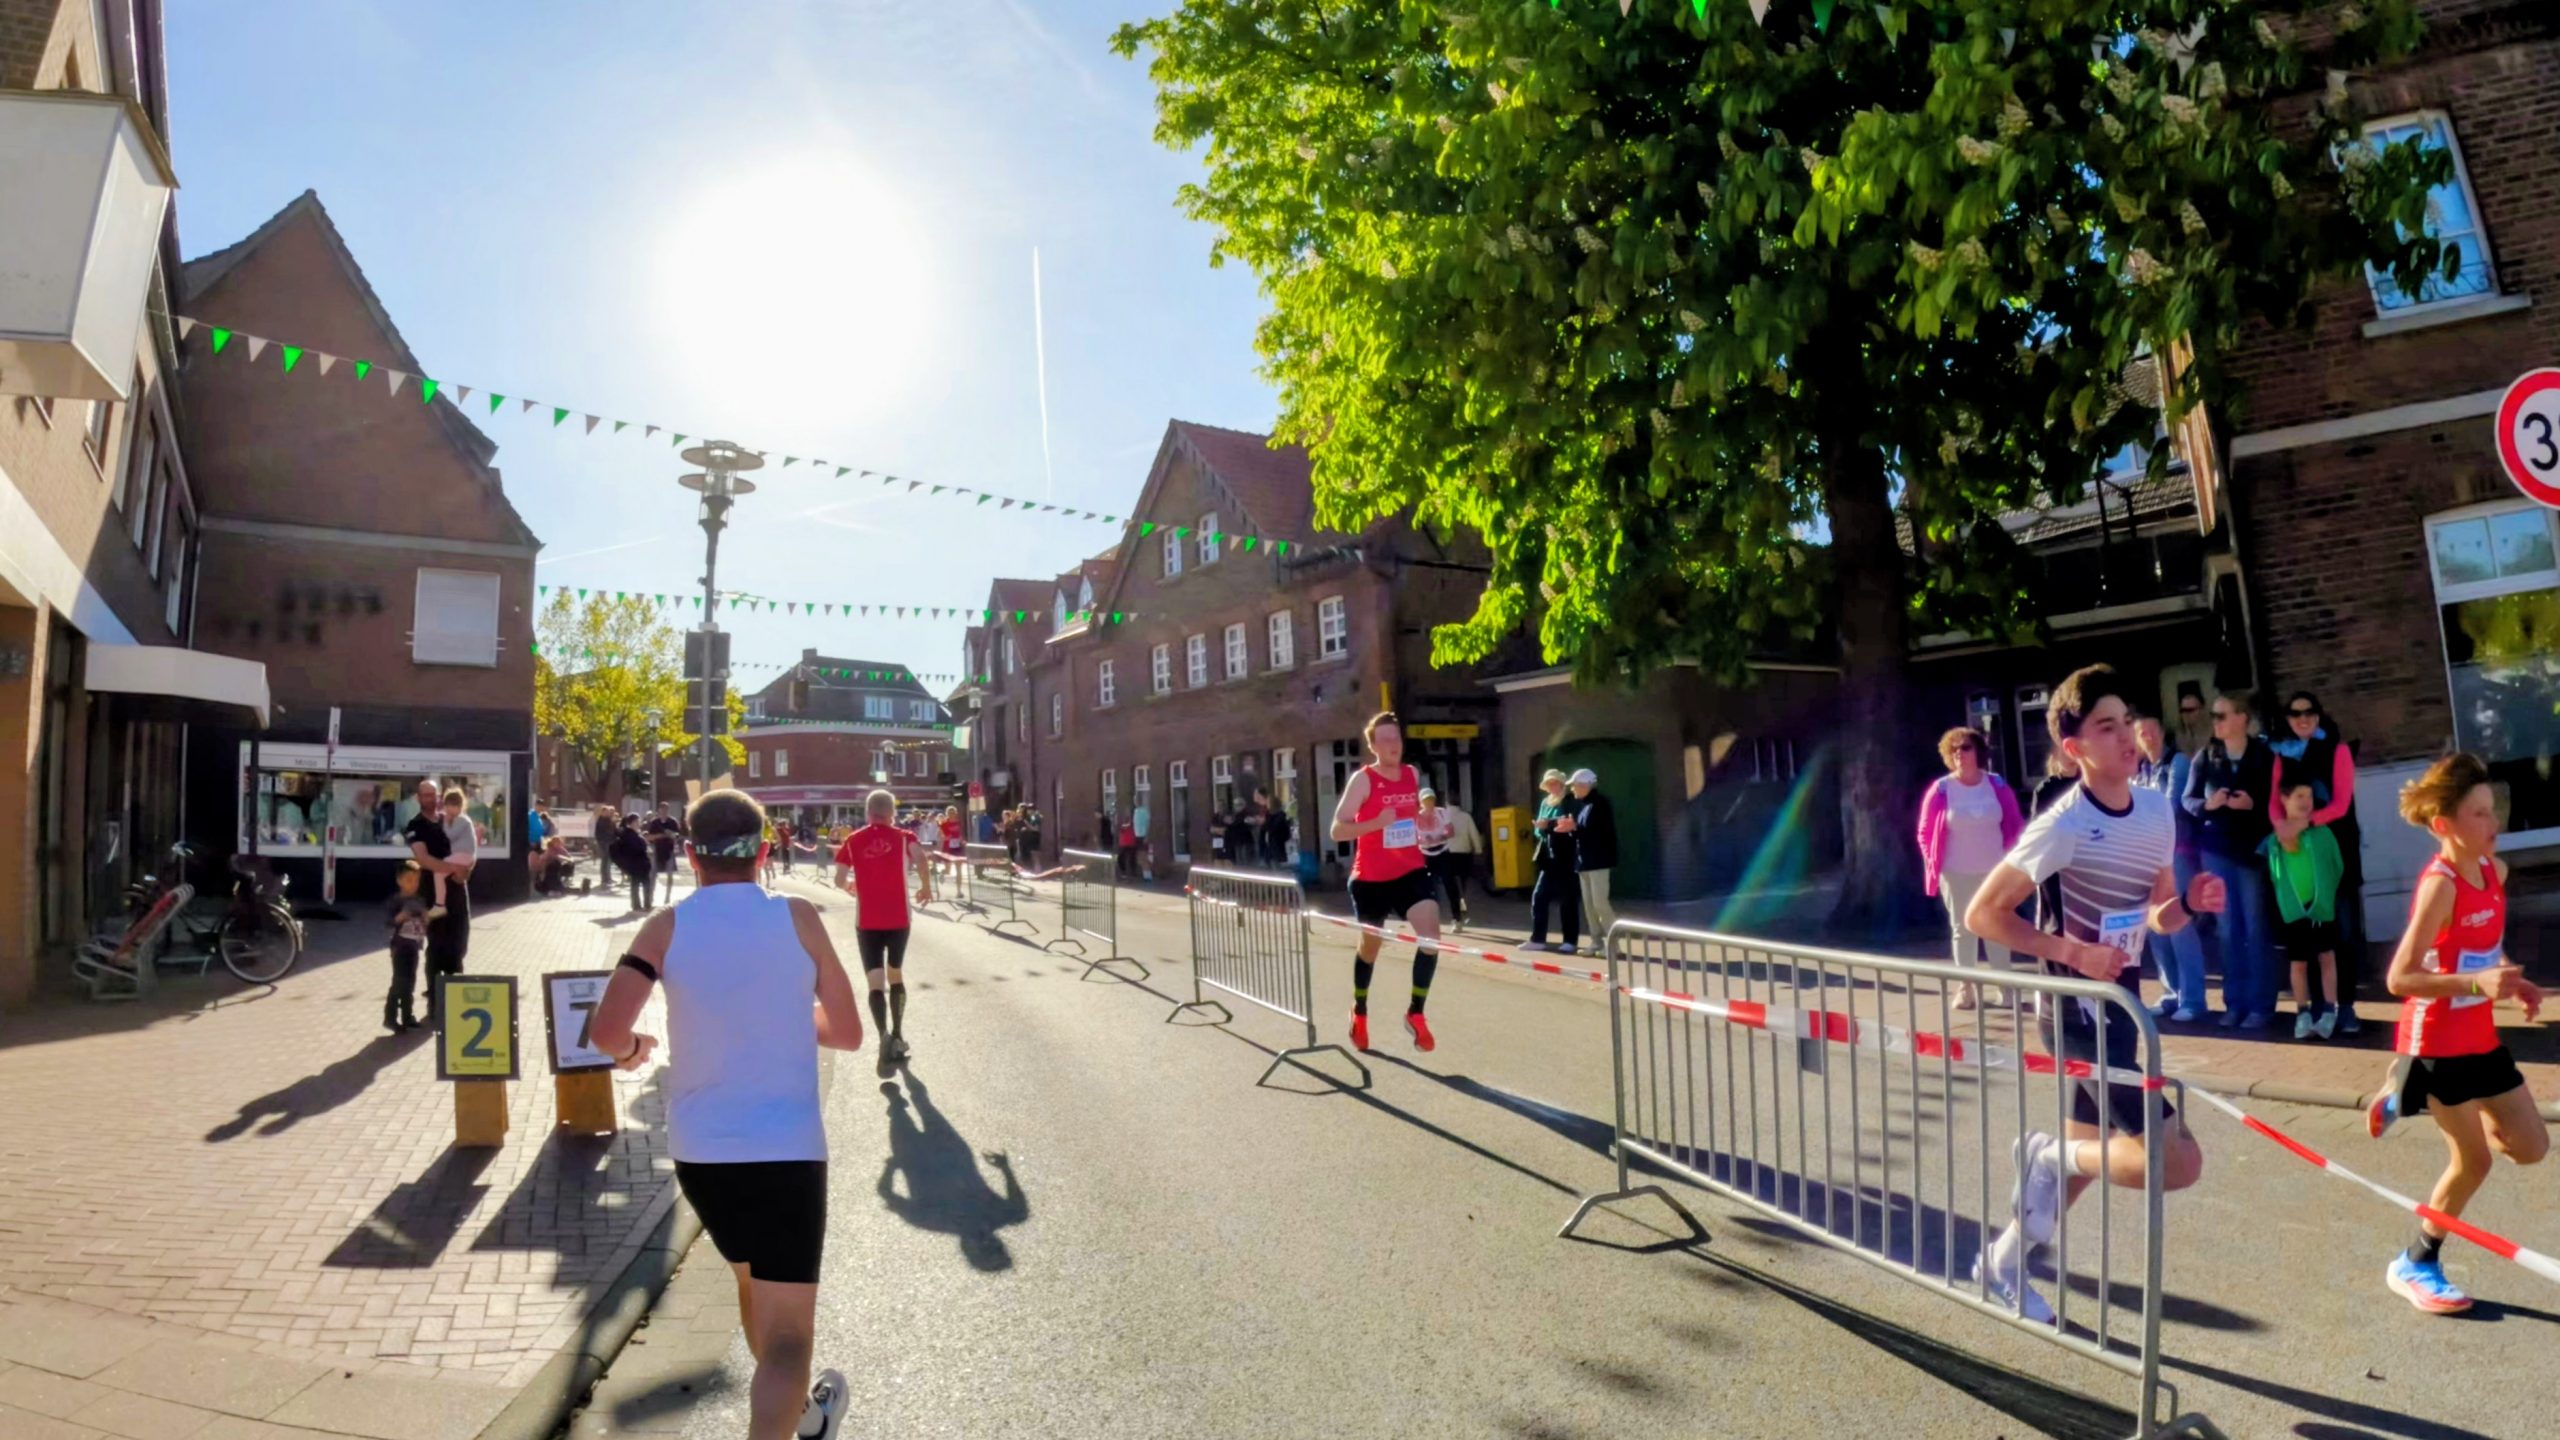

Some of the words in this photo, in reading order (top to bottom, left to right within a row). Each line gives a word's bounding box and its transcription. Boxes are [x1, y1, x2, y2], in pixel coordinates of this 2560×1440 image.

[2522, 412, 2560, 471] 3
[460, 1008, 494, 1058] 2
[569, 1001, 599, 1050] 7
